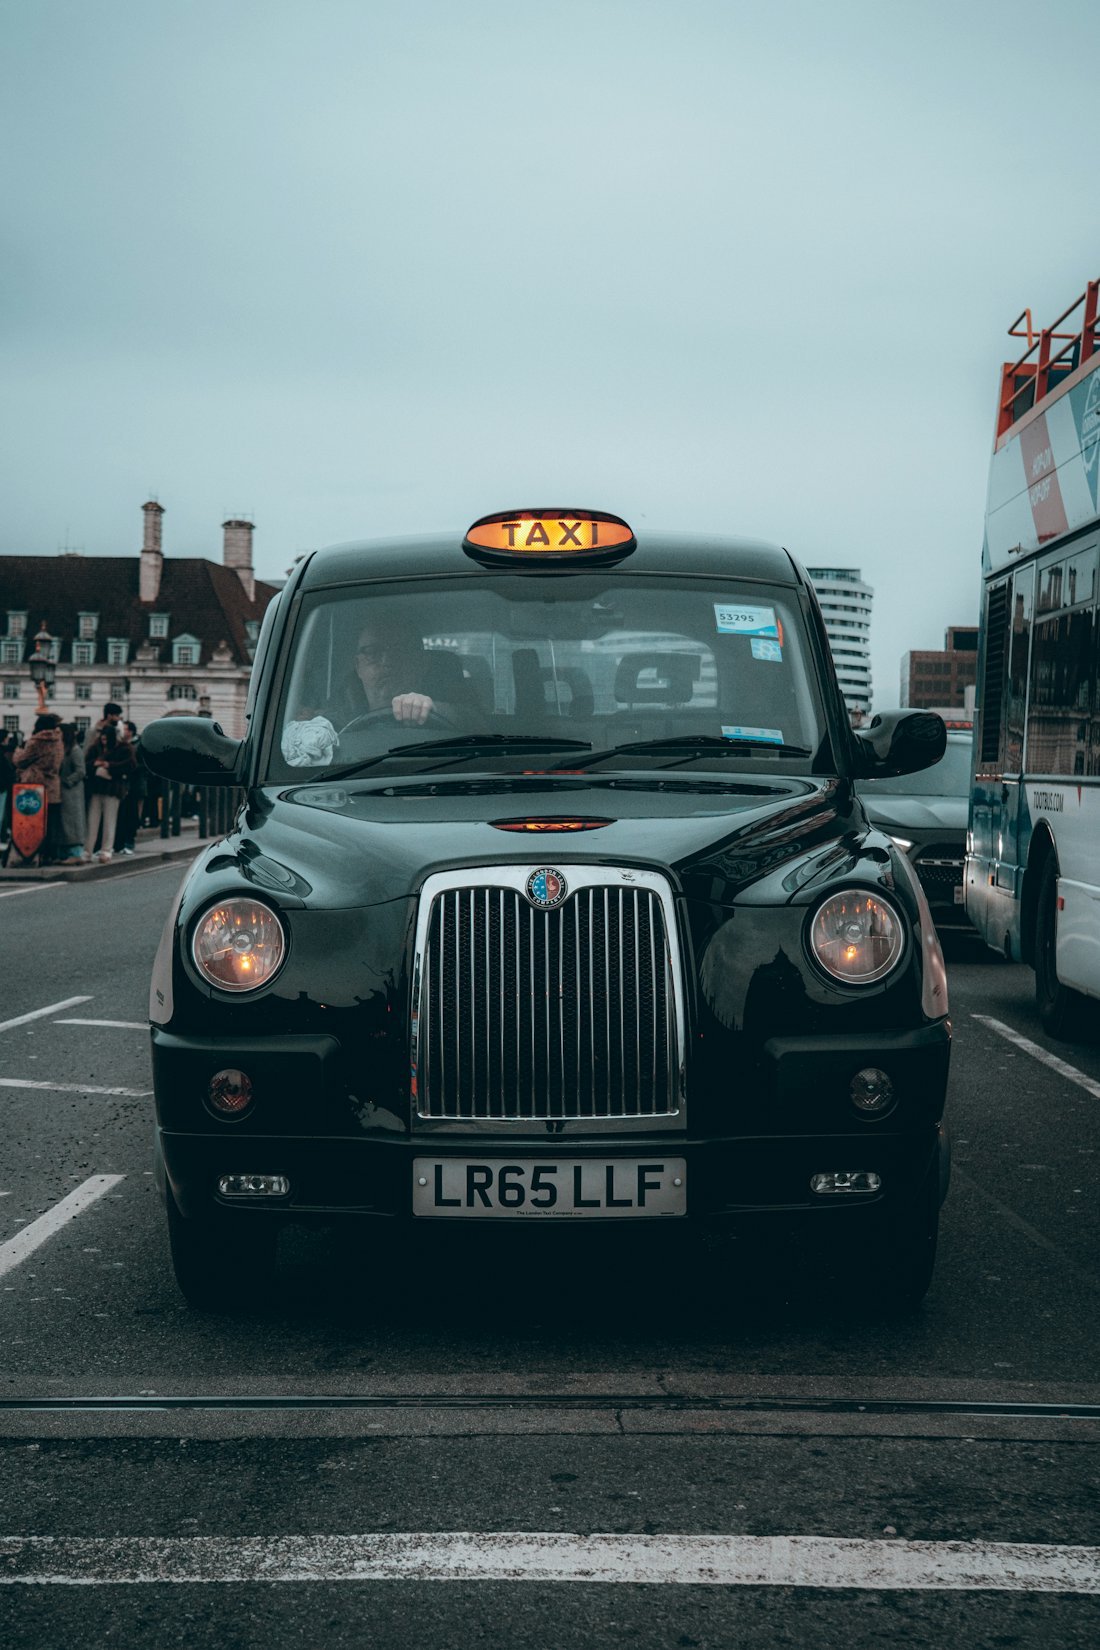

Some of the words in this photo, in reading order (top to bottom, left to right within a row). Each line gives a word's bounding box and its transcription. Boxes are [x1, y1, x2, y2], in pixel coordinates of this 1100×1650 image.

[501, 522, 598, 547] TAXI
[719, 613, 755, 623] 53295
[1033, 791, 1064, 812] TOOTBUS.COM
[434, 1164, 558, 1208] LR65
[573, 1164, 665, 1208] LLF
